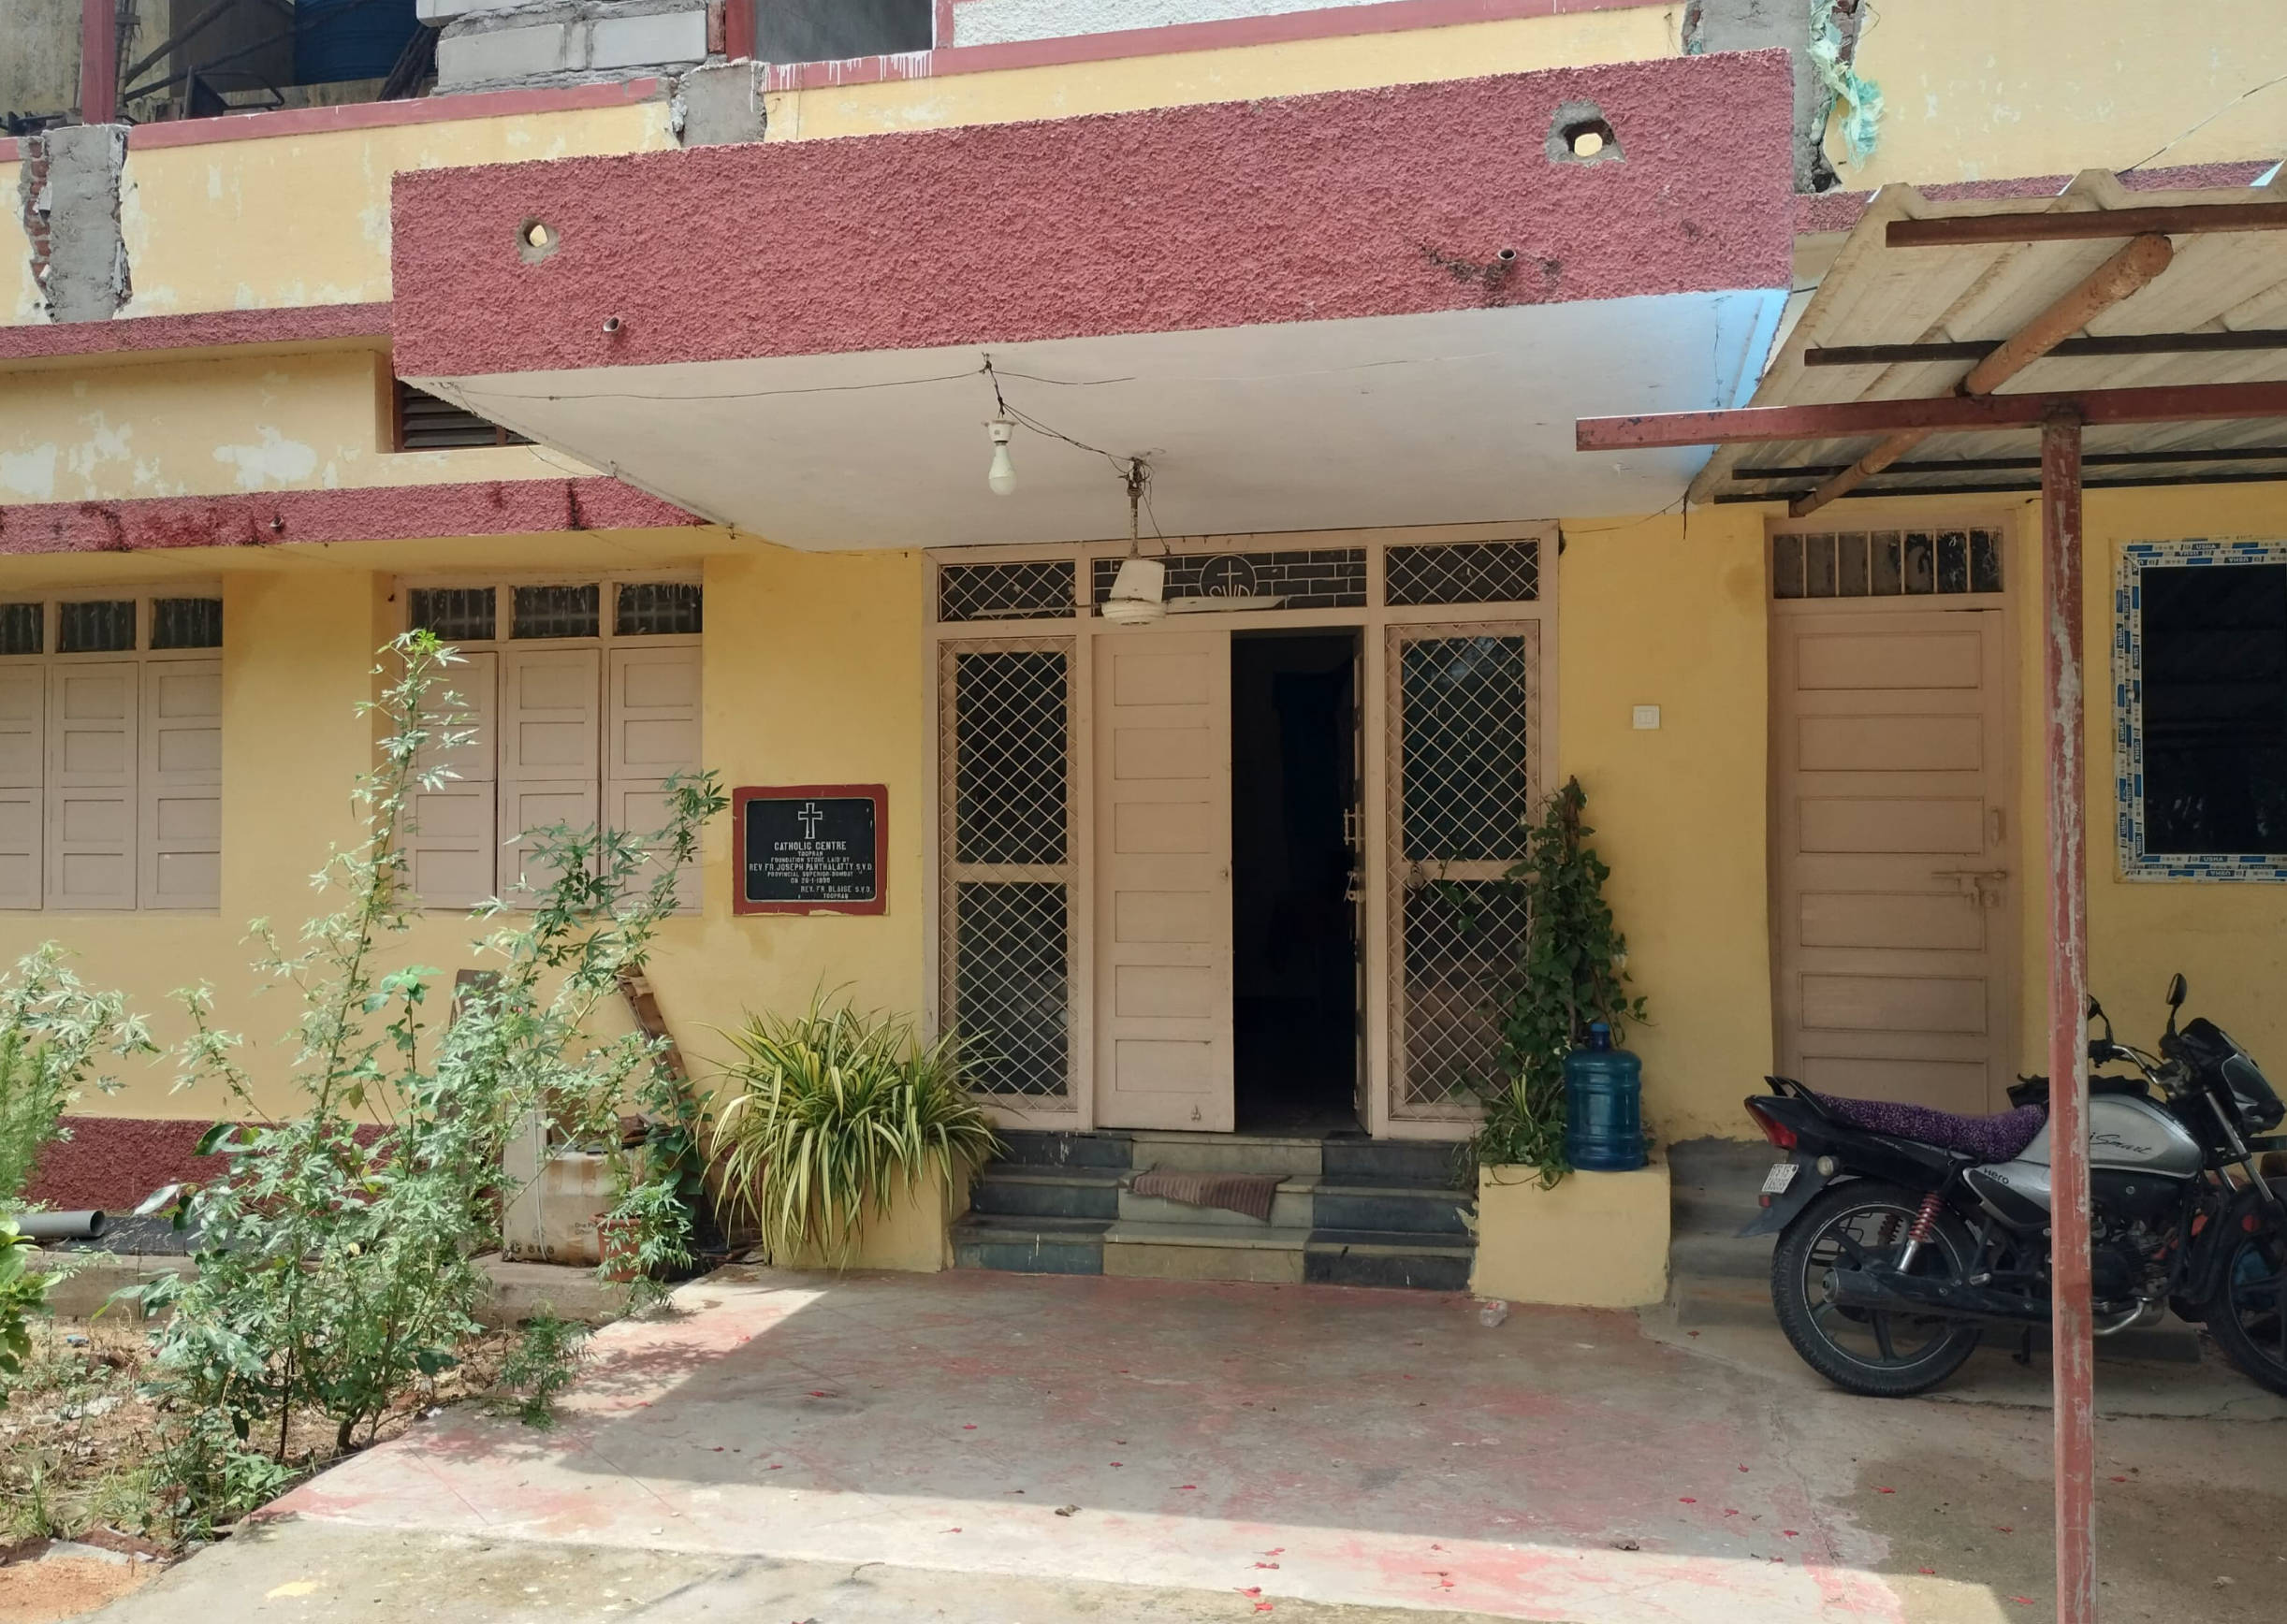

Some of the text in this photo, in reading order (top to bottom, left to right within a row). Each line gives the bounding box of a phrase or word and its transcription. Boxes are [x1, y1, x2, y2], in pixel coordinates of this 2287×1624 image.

[774, 841, 847, 851] CATHOLIC CENTRE
[776, 863, 804, 872] JOSEPH
[806, 863, 853, 871] PANTHALATTY
[1984, 1167, 2010, 1185] Hero
